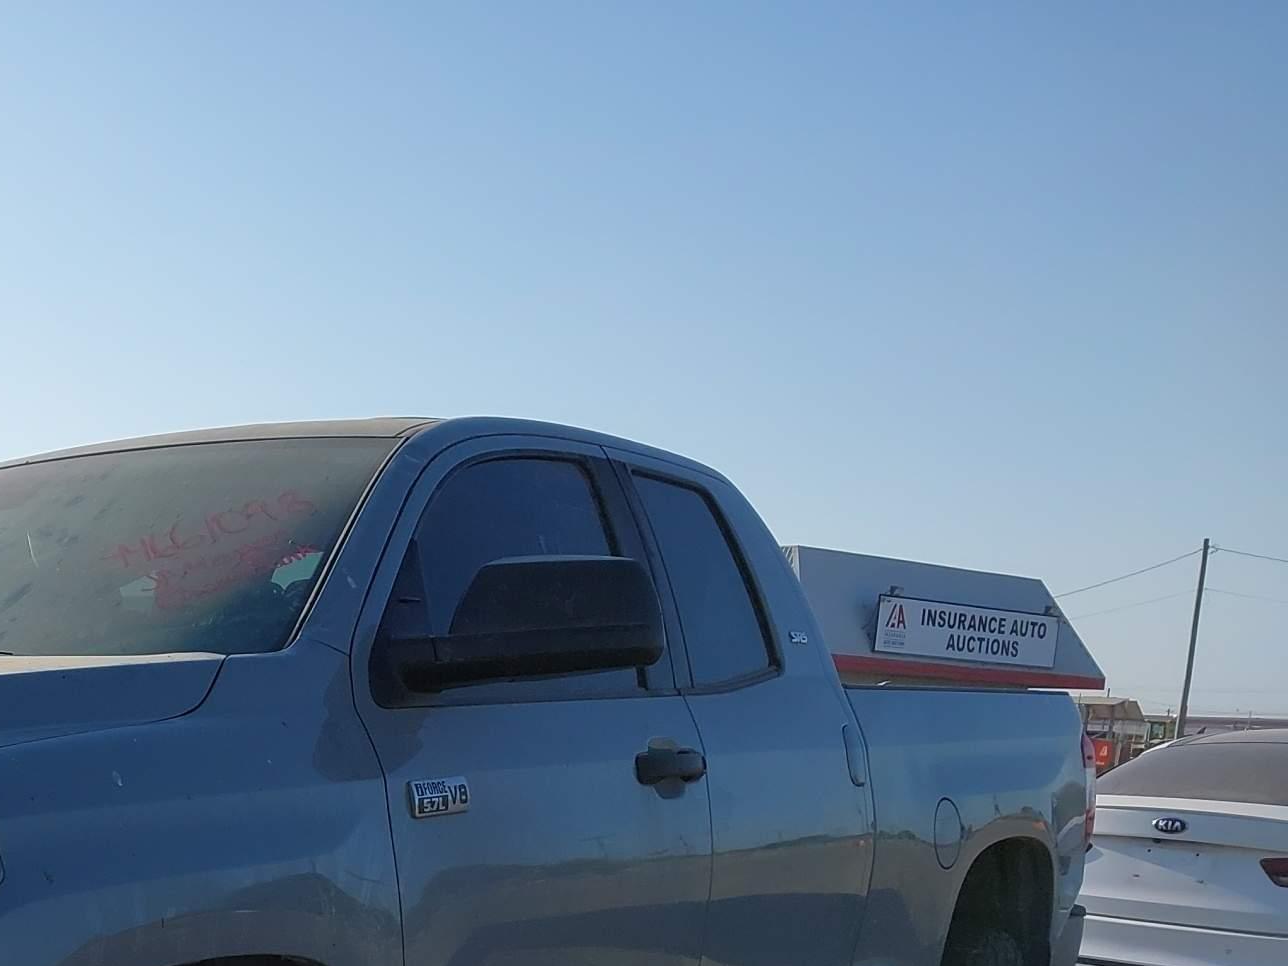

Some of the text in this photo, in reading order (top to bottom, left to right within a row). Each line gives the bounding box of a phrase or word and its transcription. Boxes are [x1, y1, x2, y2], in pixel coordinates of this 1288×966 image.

[920, 608, 1048, 640] INSURANCE AUTO
[945, 634, 1020, 658] AUCTIONS
[448, 783, 469, 805] V8
[1158, 819, 1182, 831] KIA
